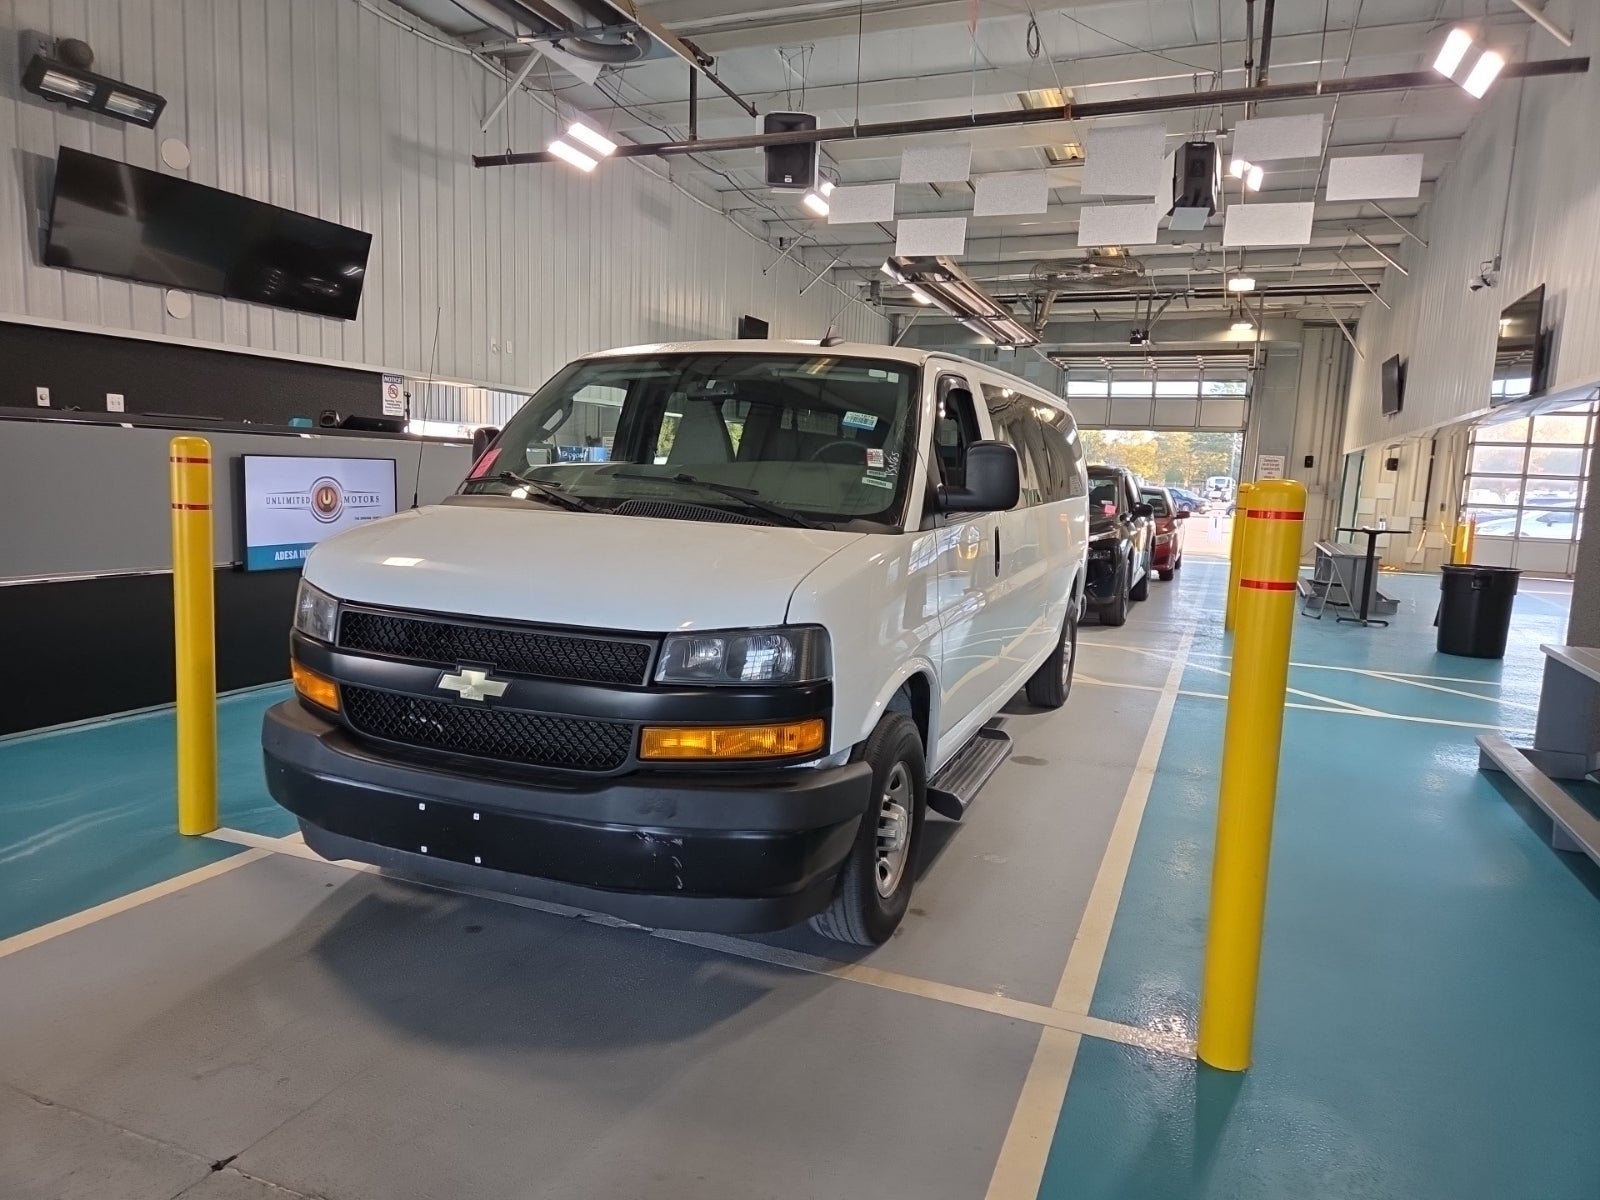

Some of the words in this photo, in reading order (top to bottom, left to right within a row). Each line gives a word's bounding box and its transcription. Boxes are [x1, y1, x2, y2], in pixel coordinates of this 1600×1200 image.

[384, 375, 402, 384] NOTICE
[266, 496, 311, 505] UNLIMITED
[343, 495, 380, 504] MOTORS
[275, 550, 298, 561] ADESA
